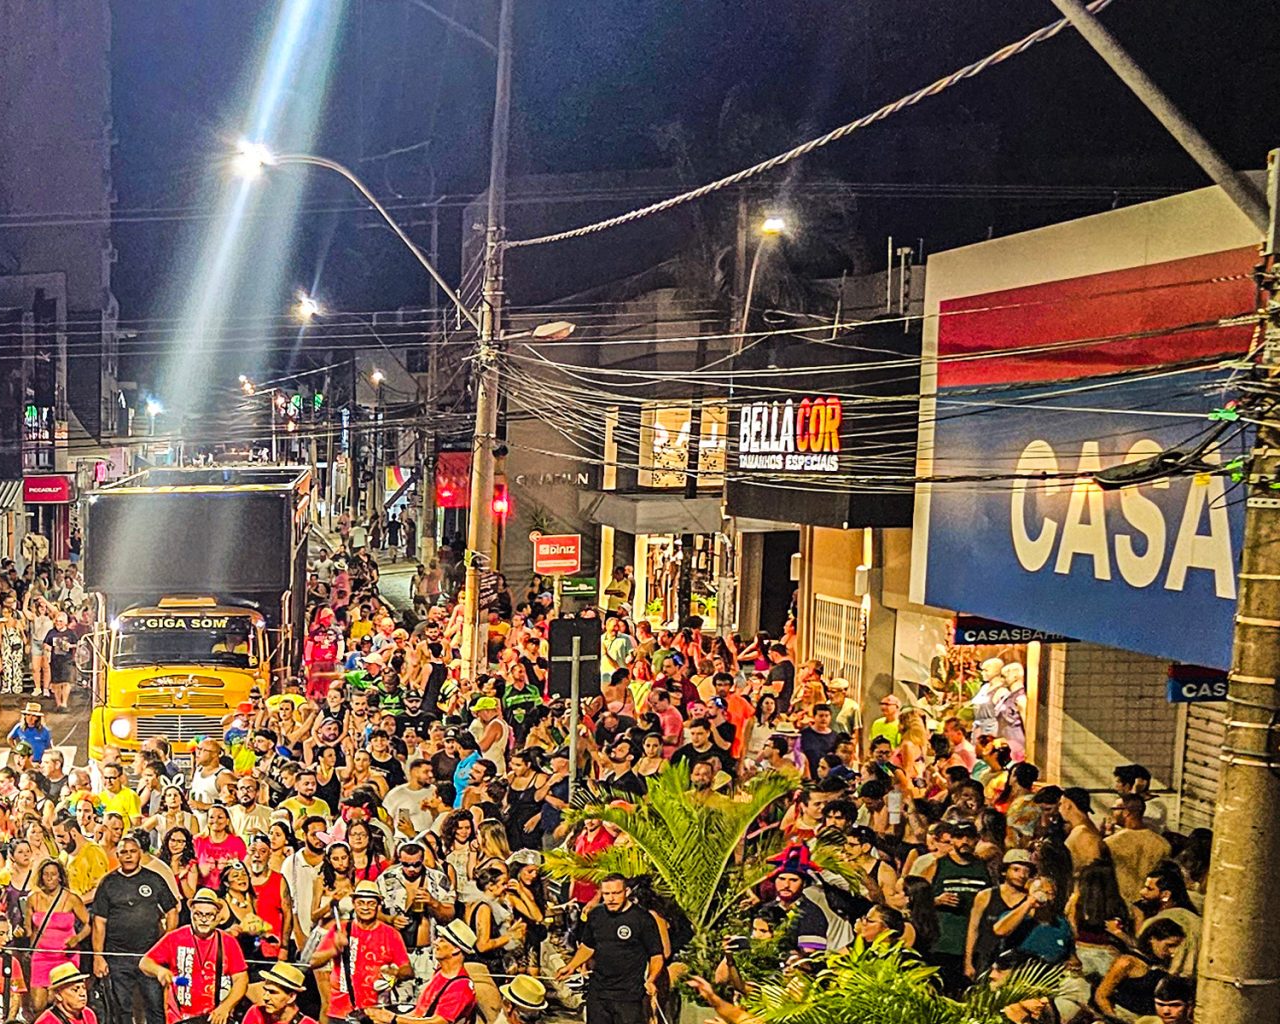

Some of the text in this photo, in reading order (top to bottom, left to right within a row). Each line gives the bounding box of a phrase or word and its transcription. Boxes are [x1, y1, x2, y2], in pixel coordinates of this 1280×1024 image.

[739, 398, 795, 453] BELLA
[796, 397, 842, 453] COR
[146, 617, 227, 629] GIGA SOM
